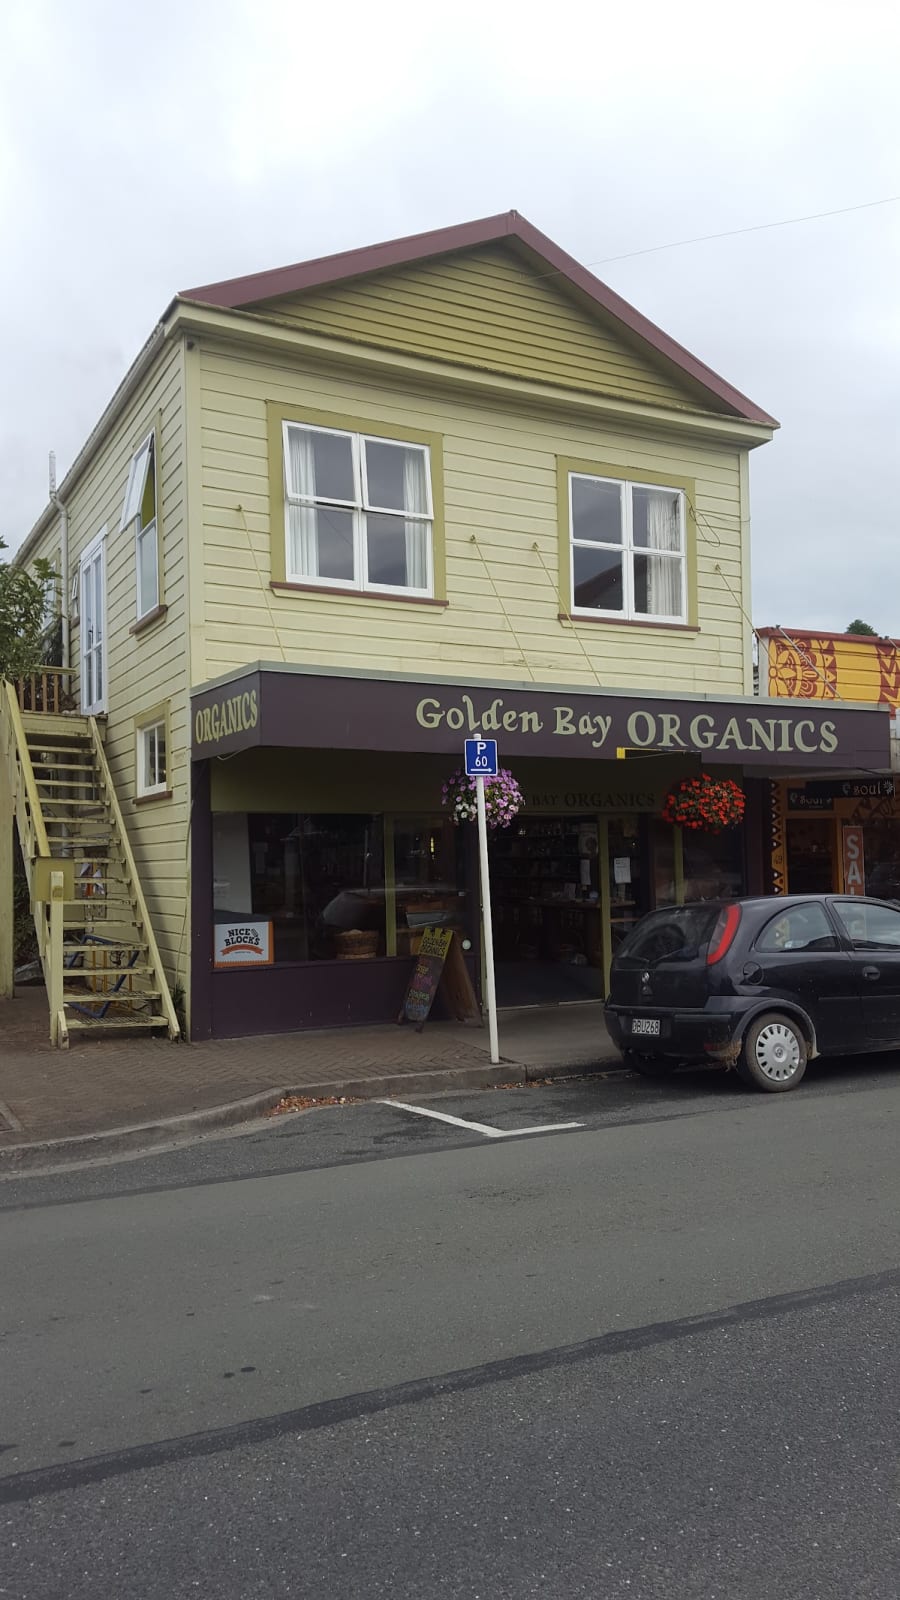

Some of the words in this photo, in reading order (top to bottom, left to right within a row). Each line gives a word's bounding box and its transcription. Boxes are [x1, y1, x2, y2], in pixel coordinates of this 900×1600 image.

[195, 689, 258, 745] ORGANICS
[415, 694, 543, 735] Golden
[552, 706, 612, 748] Bay
[626, 710, 839, 753] ORGANICS
[477, 742, 487, 755] P
[475, 755, 488, 767] 60
[532, 795, 559, 807] BAY
[564, 791, 656, 808] ORGANICS
[228, 928, 251, 938] NICE
[224, 936, 261, 946] BLOCKS
